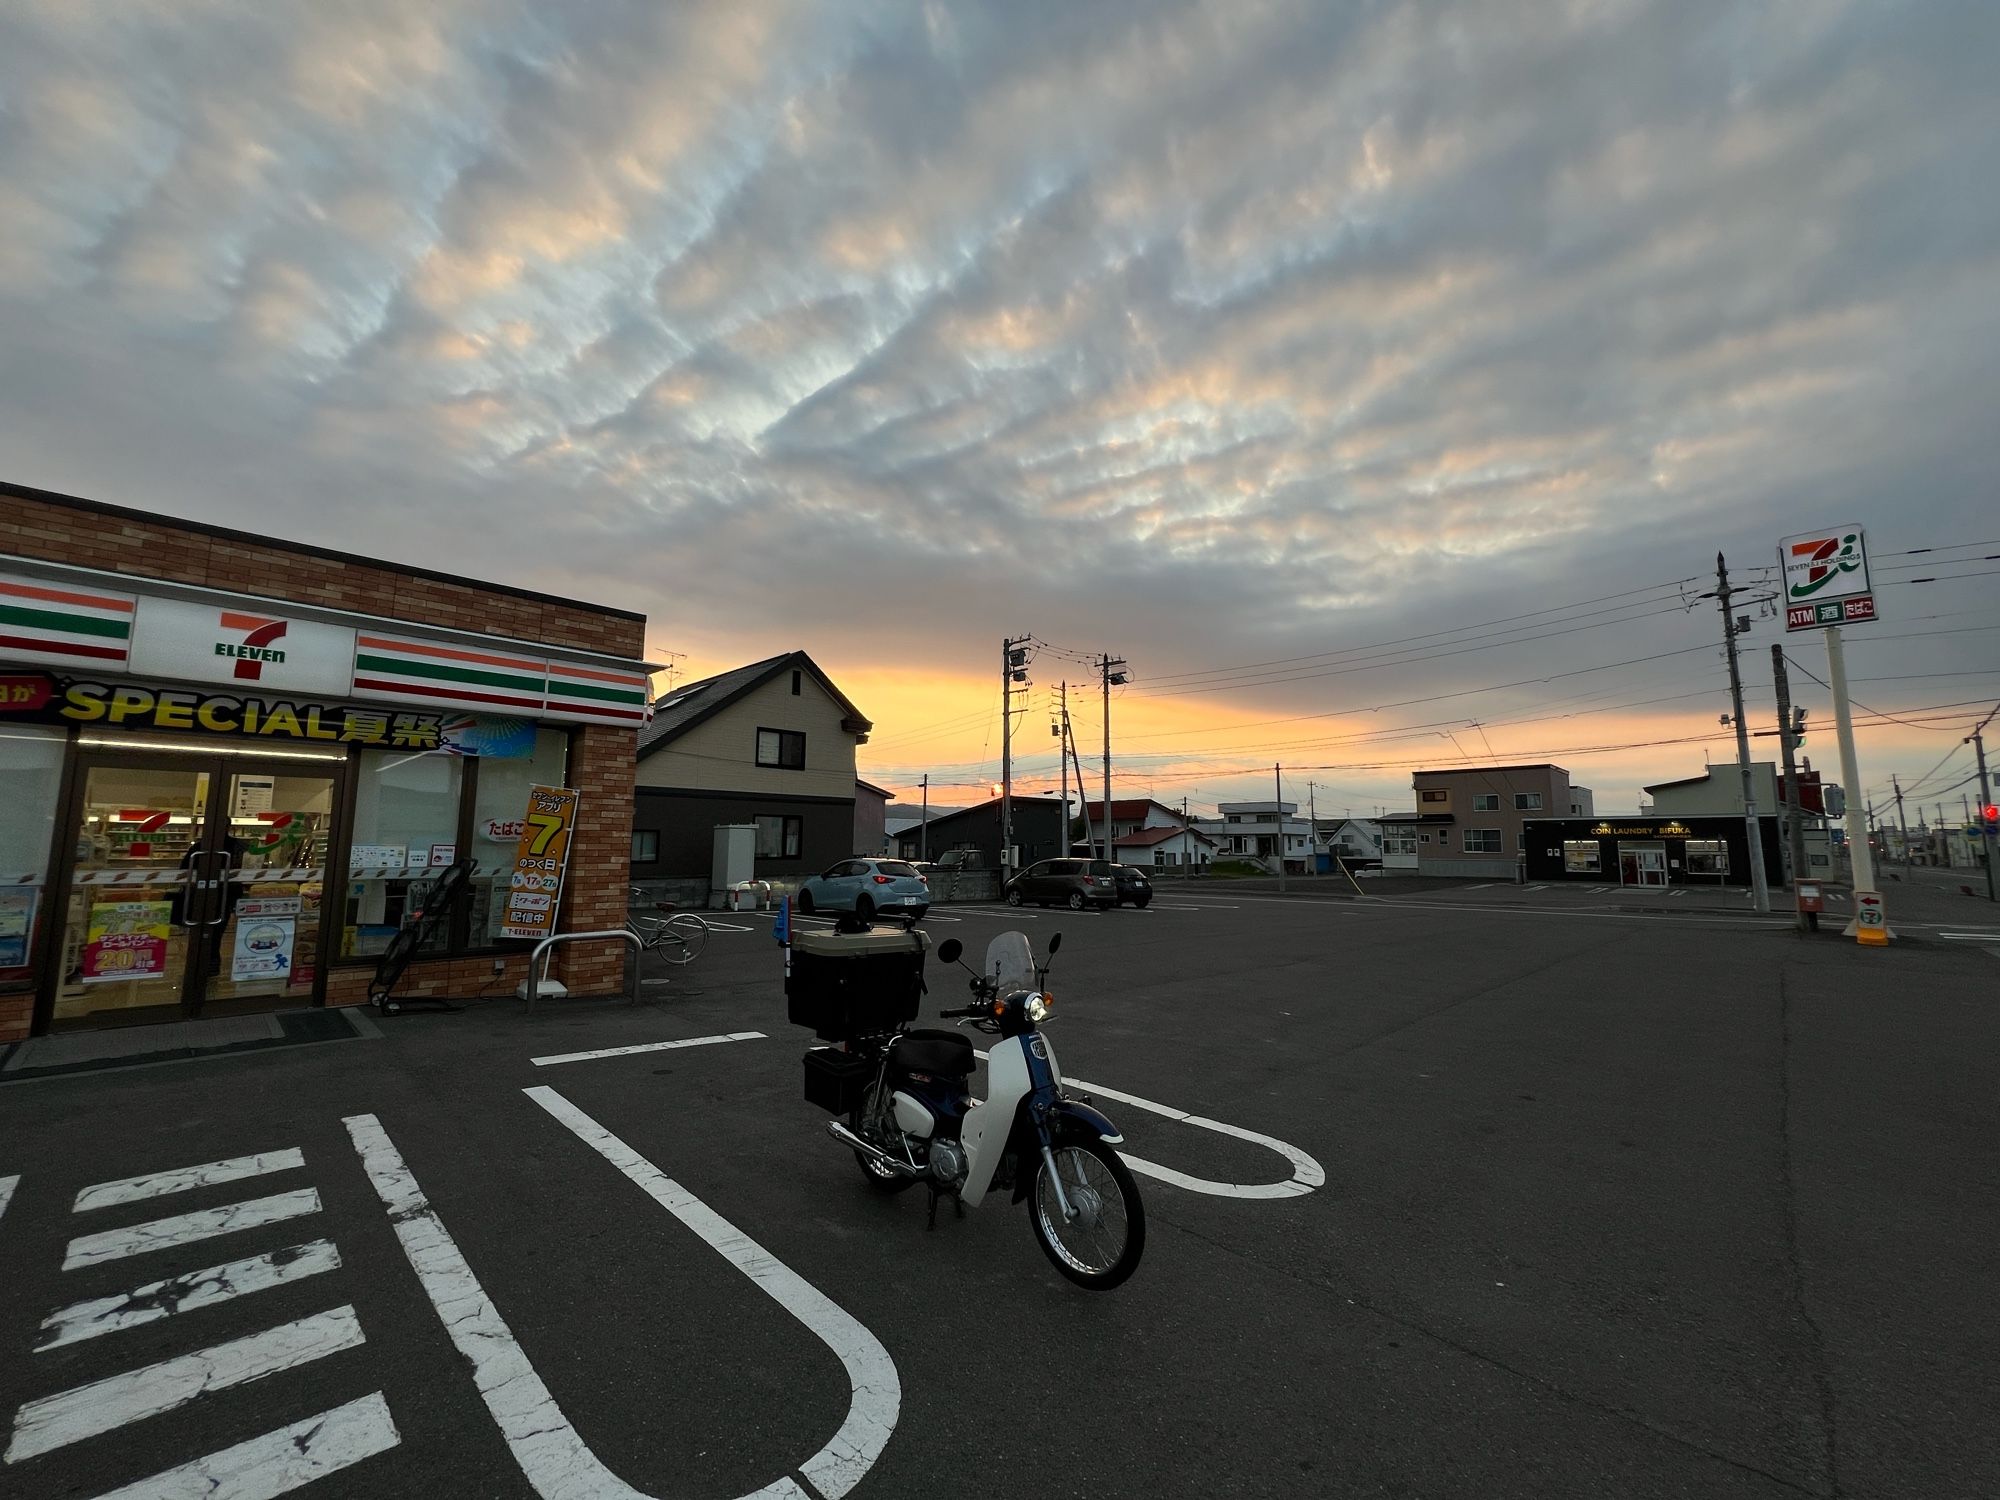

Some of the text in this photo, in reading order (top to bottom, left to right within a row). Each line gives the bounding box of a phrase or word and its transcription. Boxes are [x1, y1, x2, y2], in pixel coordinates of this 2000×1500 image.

[1821, 553, 1860, 565] HOLDINGS
[1820, 605, 1839, 620] 酒
[1844, 601, 1874, 616] たばこ
[1789, 609, 1814, 625] ATM
[221, 612, 287, 680] 7
[536, 801, 562, 813] アプリ
[489, 821, 524, 836] たばこ
[528, 813, 563, 855] 7
[519, 858, 556, 870] のつく日
[519, 897, 549, 906] クーポン
[510, 911, 545, 924] 配信中
